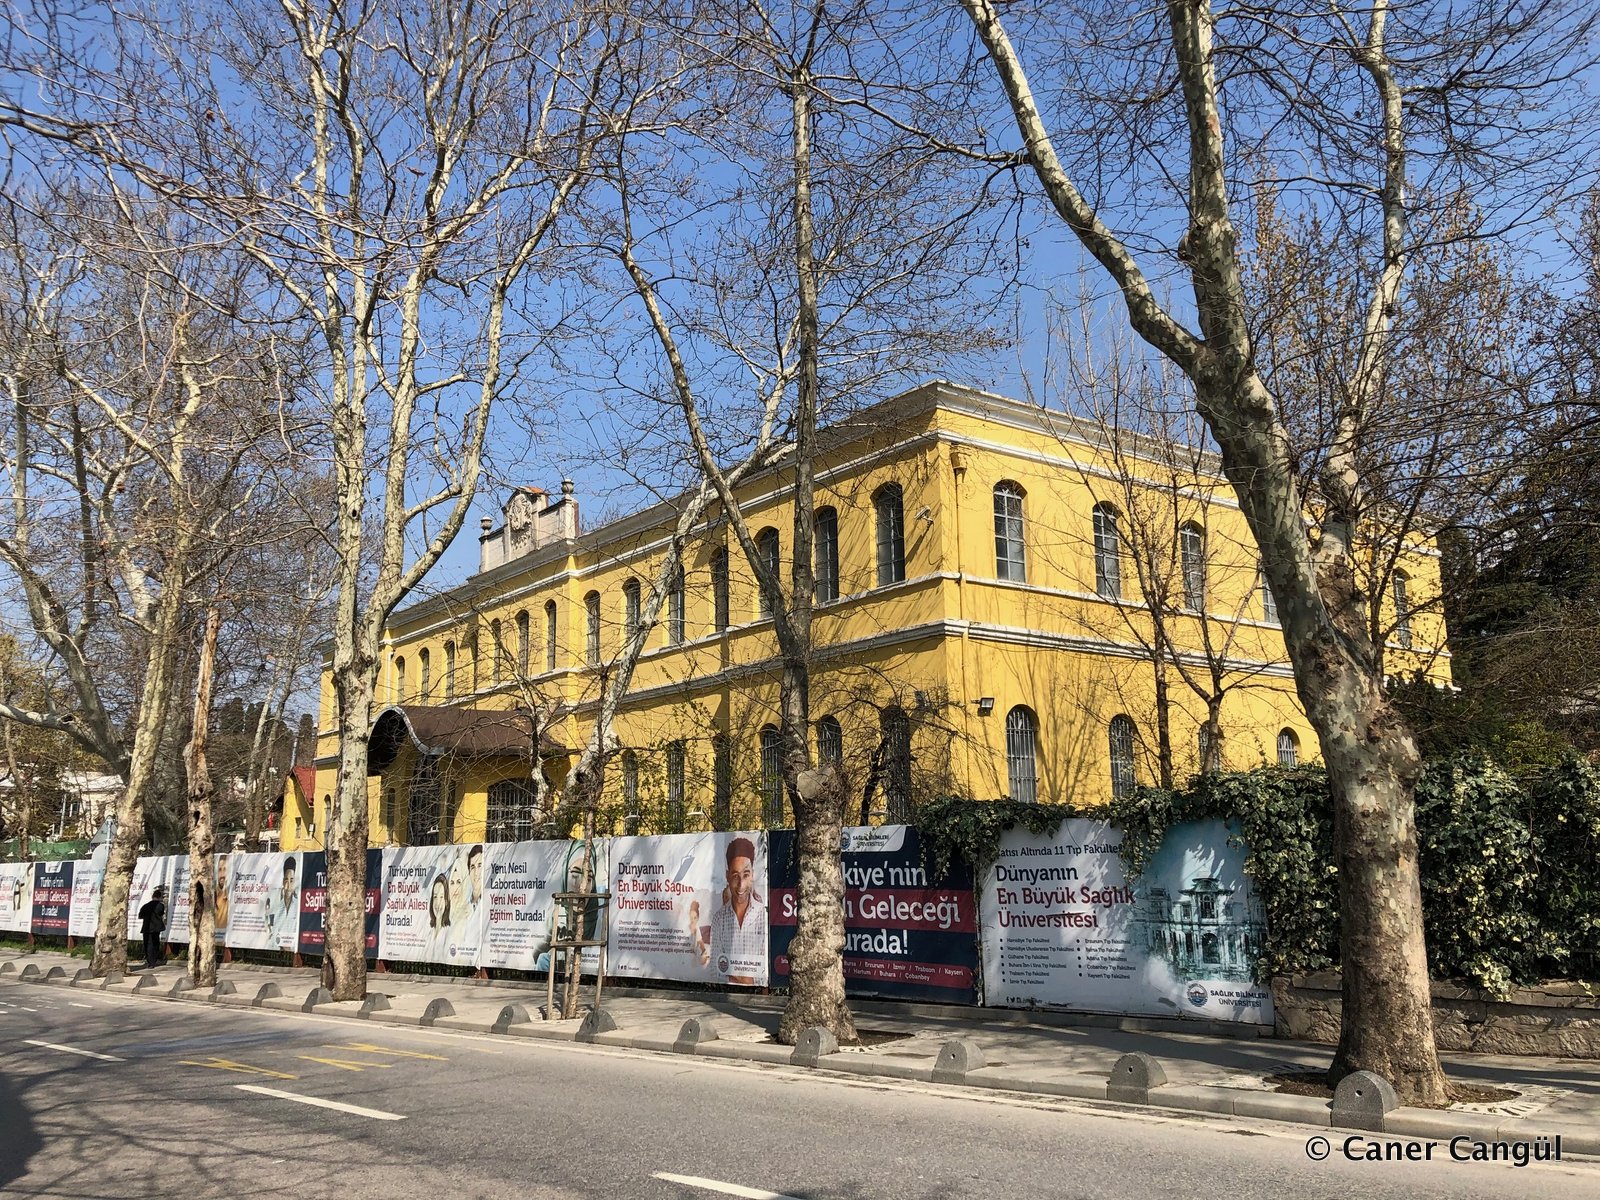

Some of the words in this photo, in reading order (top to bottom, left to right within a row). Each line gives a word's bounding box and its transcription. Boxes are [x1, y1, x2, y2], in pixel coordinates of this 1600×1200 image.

[999, 848, 1019, 857] atısı
[1020, 846, 1052, 857] Altında
[1054, 845, 1065, 855] 11
[1066, 845, 1082, 857] Tıp
[1084, 843, 1122, 854] Fakülte
[388, 865, 427, 880] Türkiye'nin
[490, 863, 507, 874] Yeni
[508, 862, 527, 874] Nesil
[618, 862, 665, 878] Dünyanın
[995, 864, 1079, 885] Dünyanın
[842, 860, 928, 892] kiye'nin
[387, 881, 396, 893] En
[397, 881, 420, 897] Büyük
[490, 878, 547, 890] Laboratuvarlar
[618, 879, 630, 892] En
[632, 879, 663, 896] Büyük
[387, 897, 407, 912] Sağlık
[408, 898, 428, 911] Ailesi
[490, 894, 506, 905] Yeni
[507, 893, 527, 906] Nesil
[617, 893, 673, 910] Üniversitesi
[996, 887, 1019, 905] En
[1022, 887, 1077, 909] Büyük
[1080, 885, 1136, 908] Sağlık
[489, 909, 514, 923] Eğitim
[515, 909, 546, 922] Burada!
[859, 894, 961, 929] Geleceği
[998, 907, 1099, 928] Üniversitesi
[386, 914, 413, 927] Burada!
[843, 928, 909, 955] urada!
[944, 968, 964, 976] Kayseri
[1210, 989, 1235, 998] SAĞLIK
[1235, 990, 1269, 999] BİLİMLERİ
[1218, 997, 1262, 1008] ÜNİVERSİTESİ
